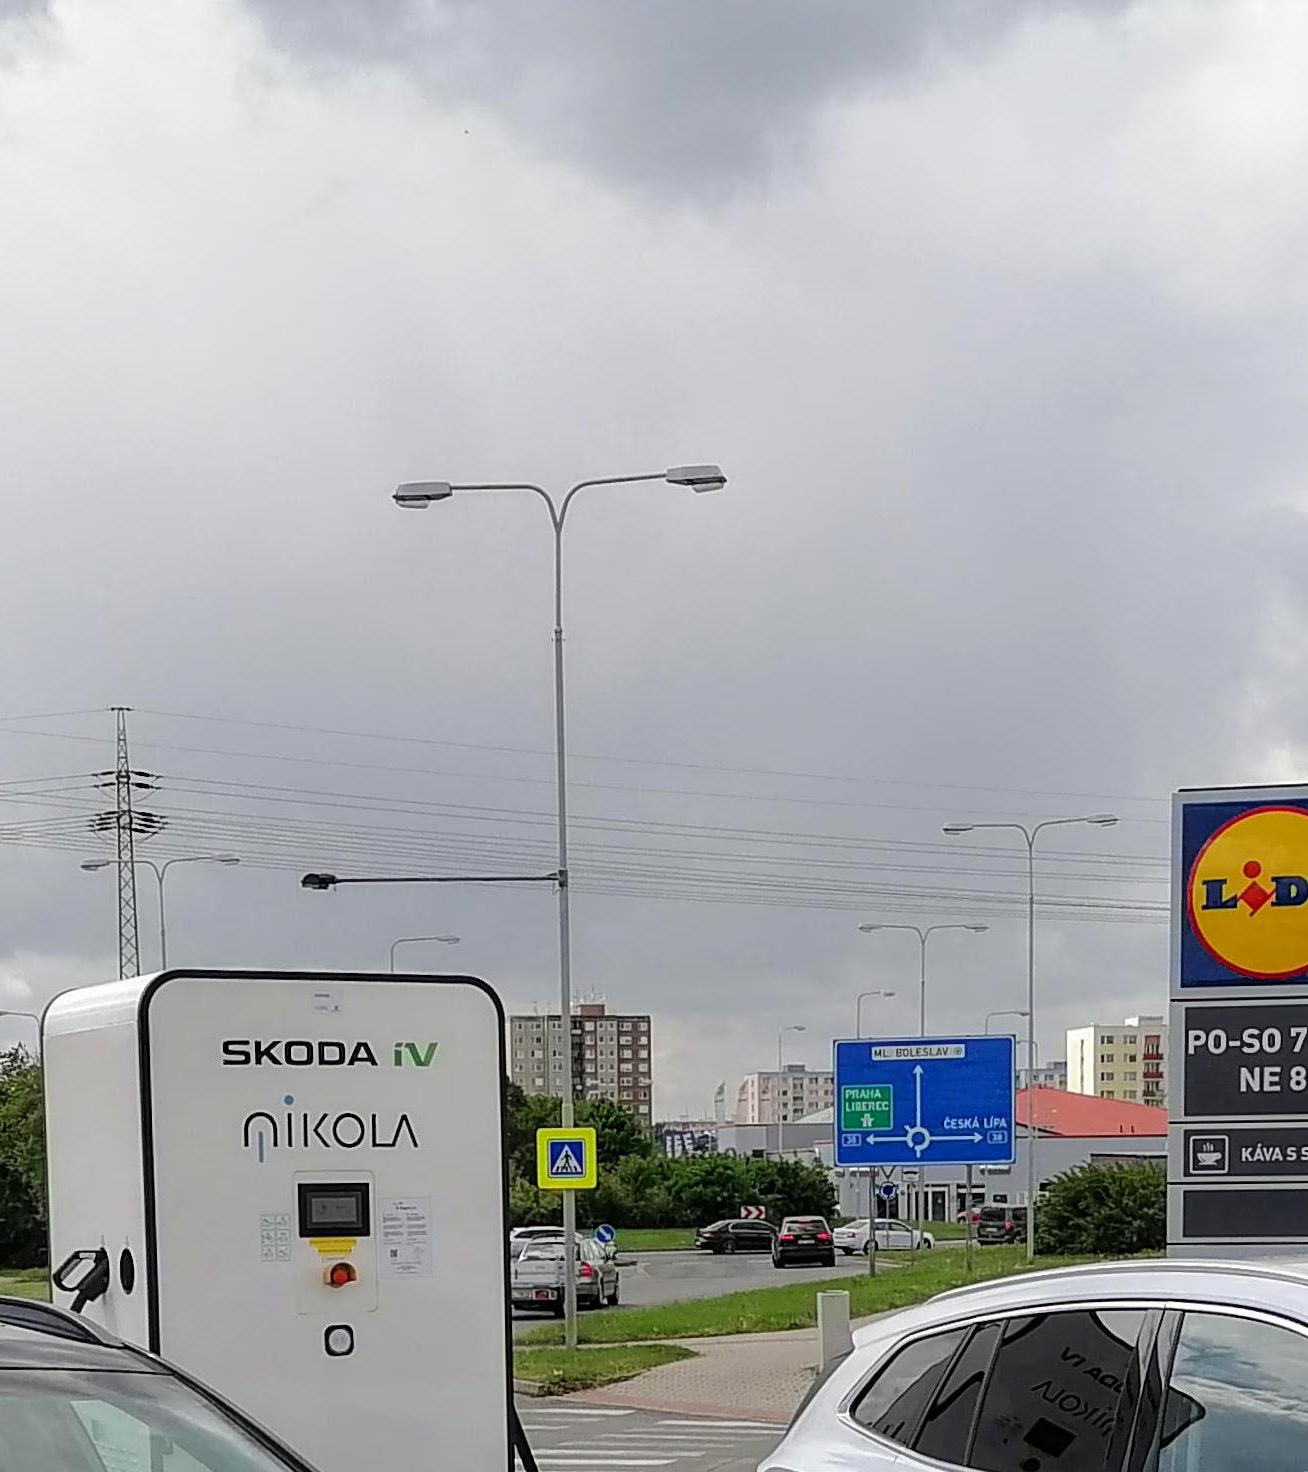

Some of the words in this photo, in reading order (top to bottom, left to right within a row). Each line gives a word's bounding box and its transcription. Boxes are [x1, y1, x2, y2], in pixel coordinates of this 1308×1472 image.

[1187, 1027, 1282, 1055] PO-SO
[222, 1040, 379, 1066] SKODA
[895, 1047, 950, 1057] BOLESLAV
[1239, 1066, 1282, 1093] NE
[845, 1089, 882, 1100] PRAHA
[844, 1101, 890, 1112] LIBEREC
[943, 1116, 980, 1130] ČESKÁ
[983, 1115, 1008, 1129] LÍPA
[1241, 1143, 1284, 1162] KÁVA
[1286, 1146, 1297, 1161] S
